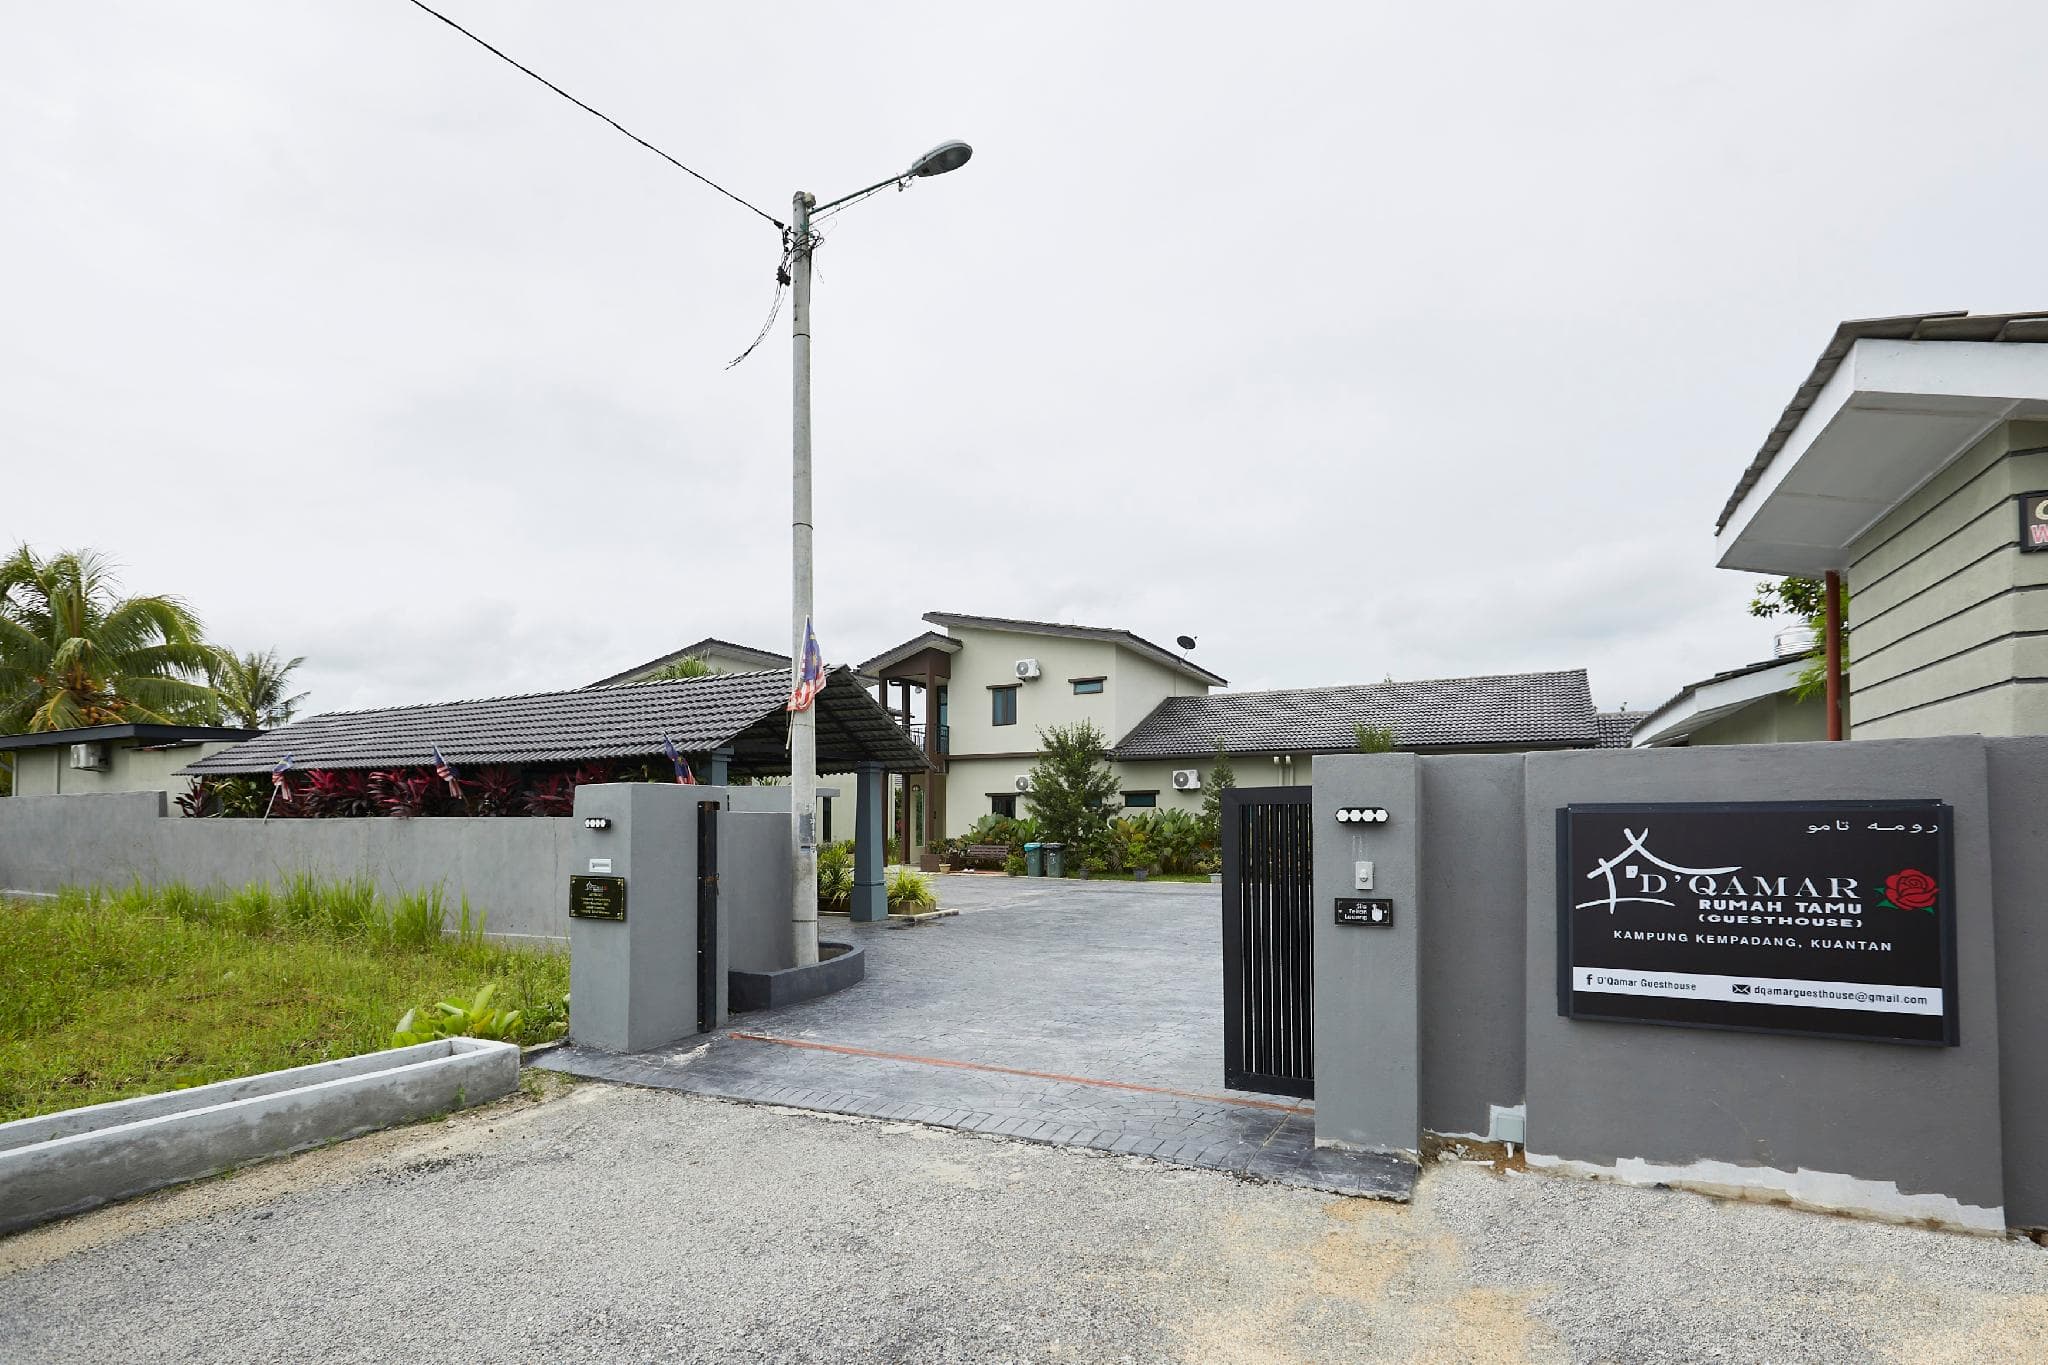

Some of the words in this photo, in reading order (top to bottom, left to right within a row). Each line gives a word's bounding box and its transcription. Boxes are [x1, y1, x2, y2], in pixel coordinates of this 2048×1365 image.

[1699, 900, 1781, 912] RUMAH
[1795, 902, 1861, 914] TAMU
[1699, 914, 1862, 927] (GUESTHOUSE)
[1614, 931, 1688, 942] KAMPUNG
[1696, 934, 1801, 948] KEMPADANG,
[1811, 940, 1891, 951] KUANTAN
[1640, 978, 1697, 991] Guesthouse
[1754, 985, 1928, 1005] dqamarguesthouse@gmail.com
